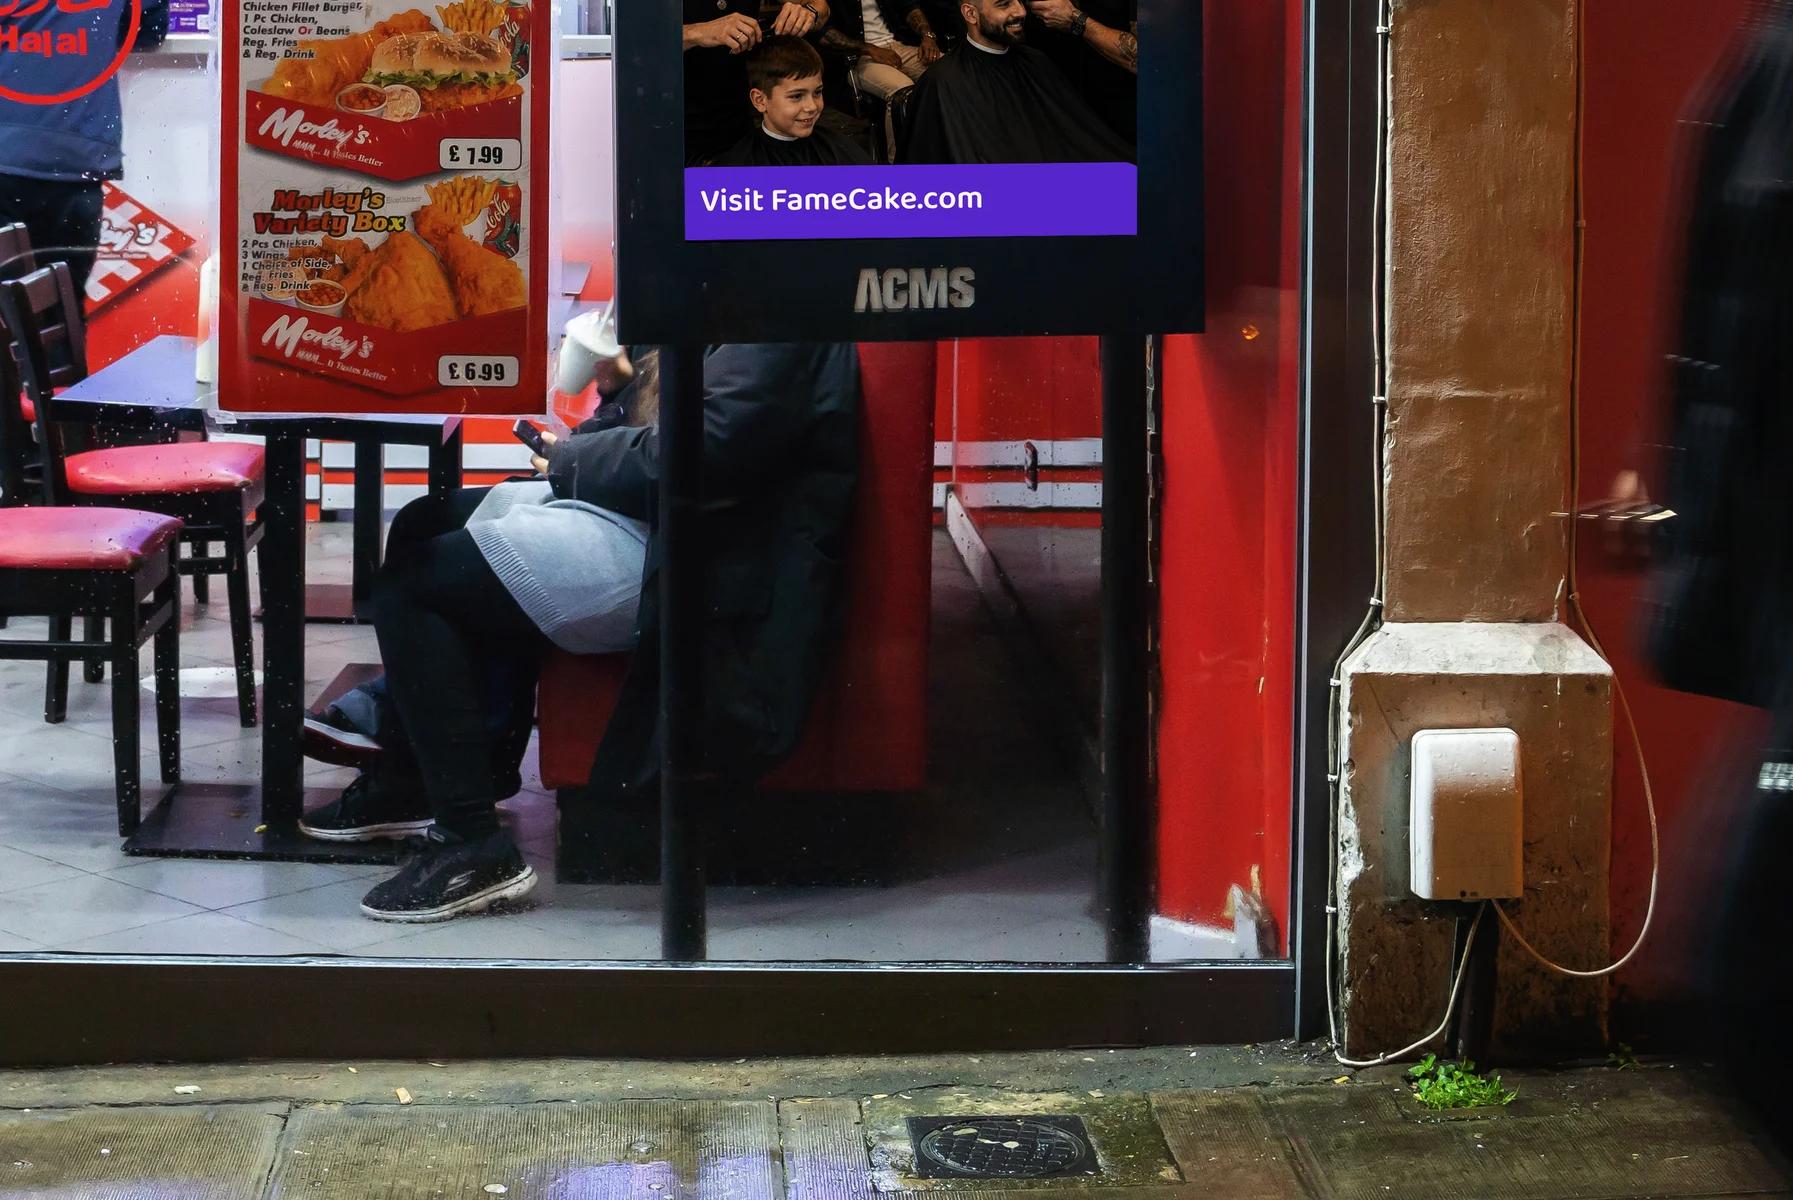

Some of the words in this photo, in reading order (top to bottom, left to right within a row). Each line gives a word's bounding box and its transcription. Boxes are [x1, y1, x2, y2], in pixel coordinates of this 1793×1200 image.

[243, 2, 288, 12] Chicken
[291, 2, 320, 11] Fillet
[323, 1, 364, 14] Burger,
[243, 14, 249, 23] 1
[253, 14, 266, 23] Pc
[270, 14, 319, 25] Chicken,
[243, 25, 295, 35] Coleslaw
[298, 25, 313, 35] Or
[0, 24, 88, 58] Halal
[243, 38, 267, 49] Reg.
[271, 38, 298, 47] Fries
[243, 50, 251, 59] &
[255, 49, 280, 60] Reg.
[284, 49, 315, 59] Drink
[258, 107, 370, 151] Morley's
[449, 144, 460, 162] £
[357, 154, 384, 167] Better
[271, 186, 386, 214] Morley's
[700, 187, 764, 212] Visit
[772, 186, 983, 211] FameCake.com
[253, 210, 349, 237] Variety
[352, 209, 407, 232] Box
[241, 239, 248, 248] 2
[251, 239, 269, 248] Pcs
[272, 238, 318, 249] Chicken,
[241, 251, 248, 259] 3
[242, 261, 247, 270] 1
[290, 258, 304, 268] of
[305, 258, 332, 270] Side,
[269, 270, 294, 279] Fries
[253, 281, 277, 291] Reg.
[280, 281, 311, 290] Drink
[853, 265, 976, 313] ACMS
[261, 314, 374, 360] Morley's
[336, 361, 361, 375] Tastes
[362, 368, 388, 382] Better
[448, 362, 460, 380] £
